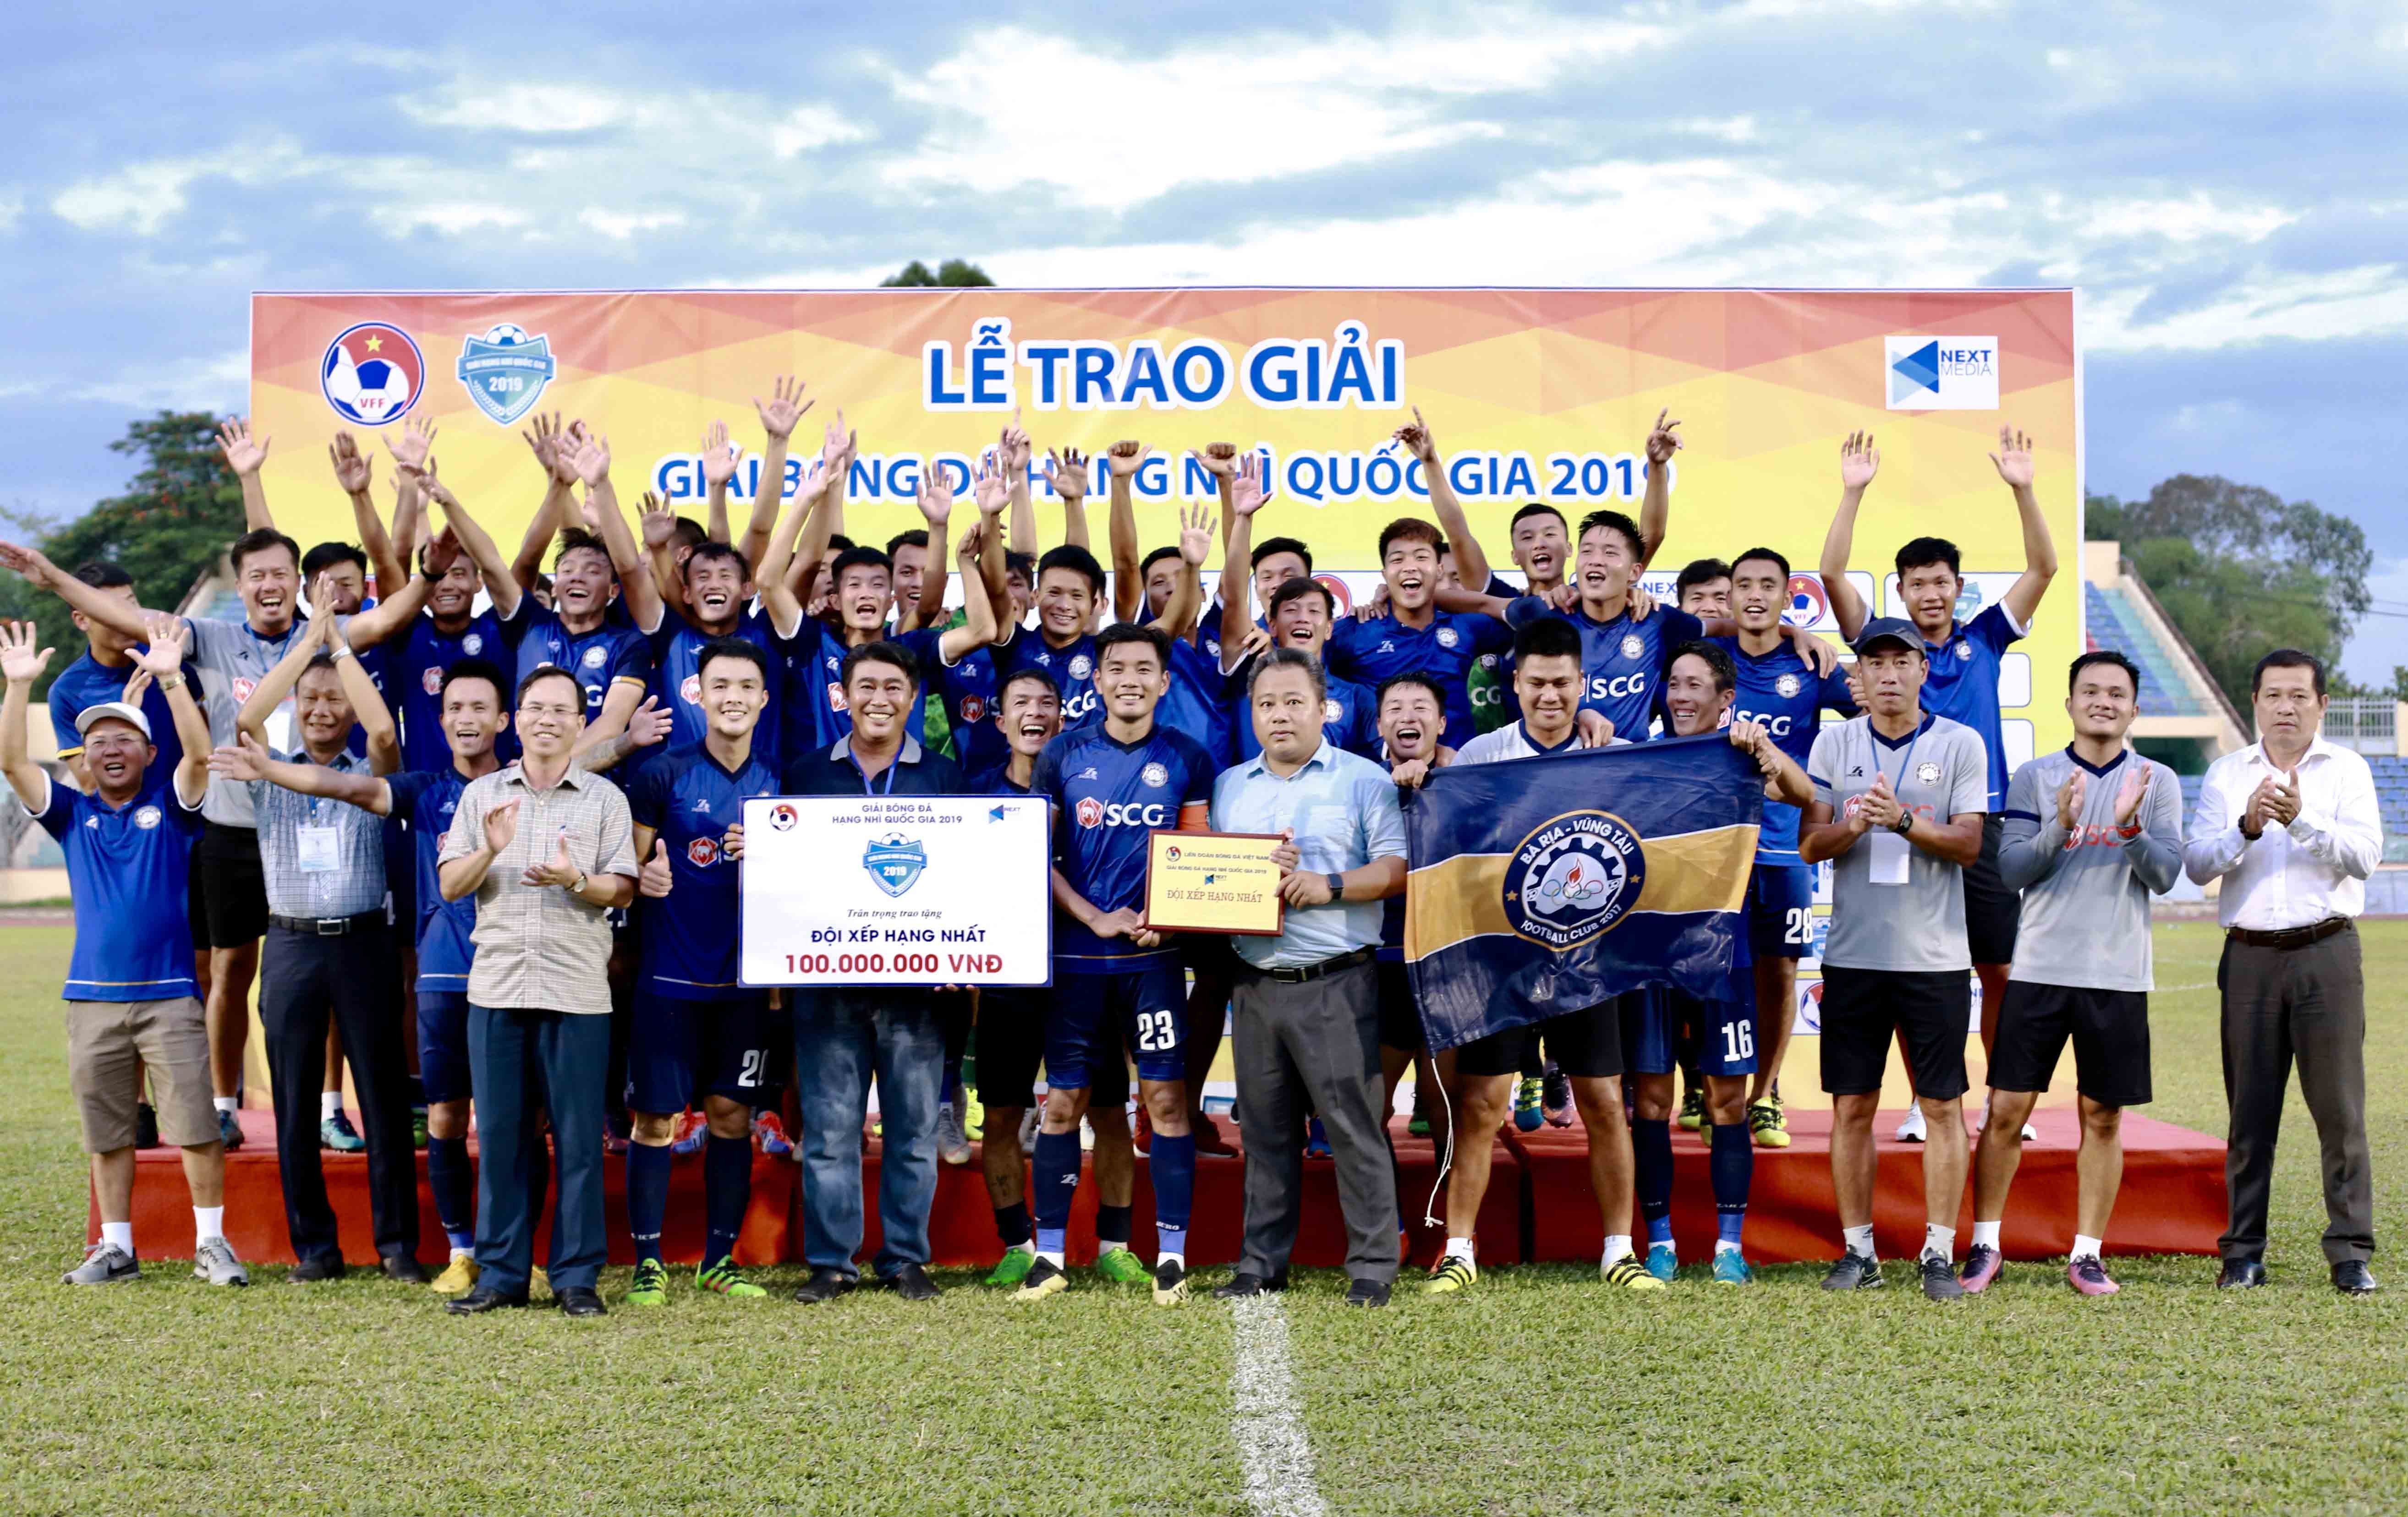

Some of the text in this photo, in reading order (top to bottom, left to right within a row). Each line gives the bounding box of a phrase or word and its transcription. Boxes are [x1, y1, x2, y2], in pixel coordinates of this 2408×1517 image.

[930, 324, 1396, 404] LỄ TRAO GIẢI
[1941, 350, 1991, 362] NEXT
[1941, 363, 1992, 376] MEDIA
[488, 376, 523, 391] 2019
[360, 398, 386, 409] VFF
[658, 447, 758, 498] GII
[780, 446, 918, 498] BNG
[1026, 456, 1168, 496] HG
[1185, 448, 1270, 496] NÌ
[1287, 440, 1431, 501] QUỐC
[1449, 456, 1536, 496] GIA
[1642, 582, 1678, 593] NEX
[1470, 685, 1501, 706] CG
[1591, 672, 1645, 700] SCG
[861, 802, 932, 812] GIẢI BÓNG ĐÁ
[1105, 803, 1164, 827] SCG
[884, 812, 915, 824] QUỐC
[1519, 844, 1541, 865] BÀ
[1538, 827, 1565, 844] RỊA
[1573, 817, 1612, 837] VŨNG
[1610, 830, 1635, 855] TÀU
[2085, 825, 2120, 847] SC
[883, 866, 907, 876] 2019
[1186, 887, 1206, 900] XẾP
[1207, 892, 1235, 904] HẠNG
[872, 910, 897, 920] trọng
[811, 924, 986, 946] ĐỘI XẾP HẠNG NHẤT
[1569, 923, 1599, 939] CLUB
[1784, 908, 1813, 944] 28
[785, 954, 1004, 974] 100.000.000 VNĐ
[1137, 1009, 1175, 1051] 23
[1721, 1019, 1754, 1062] 16
